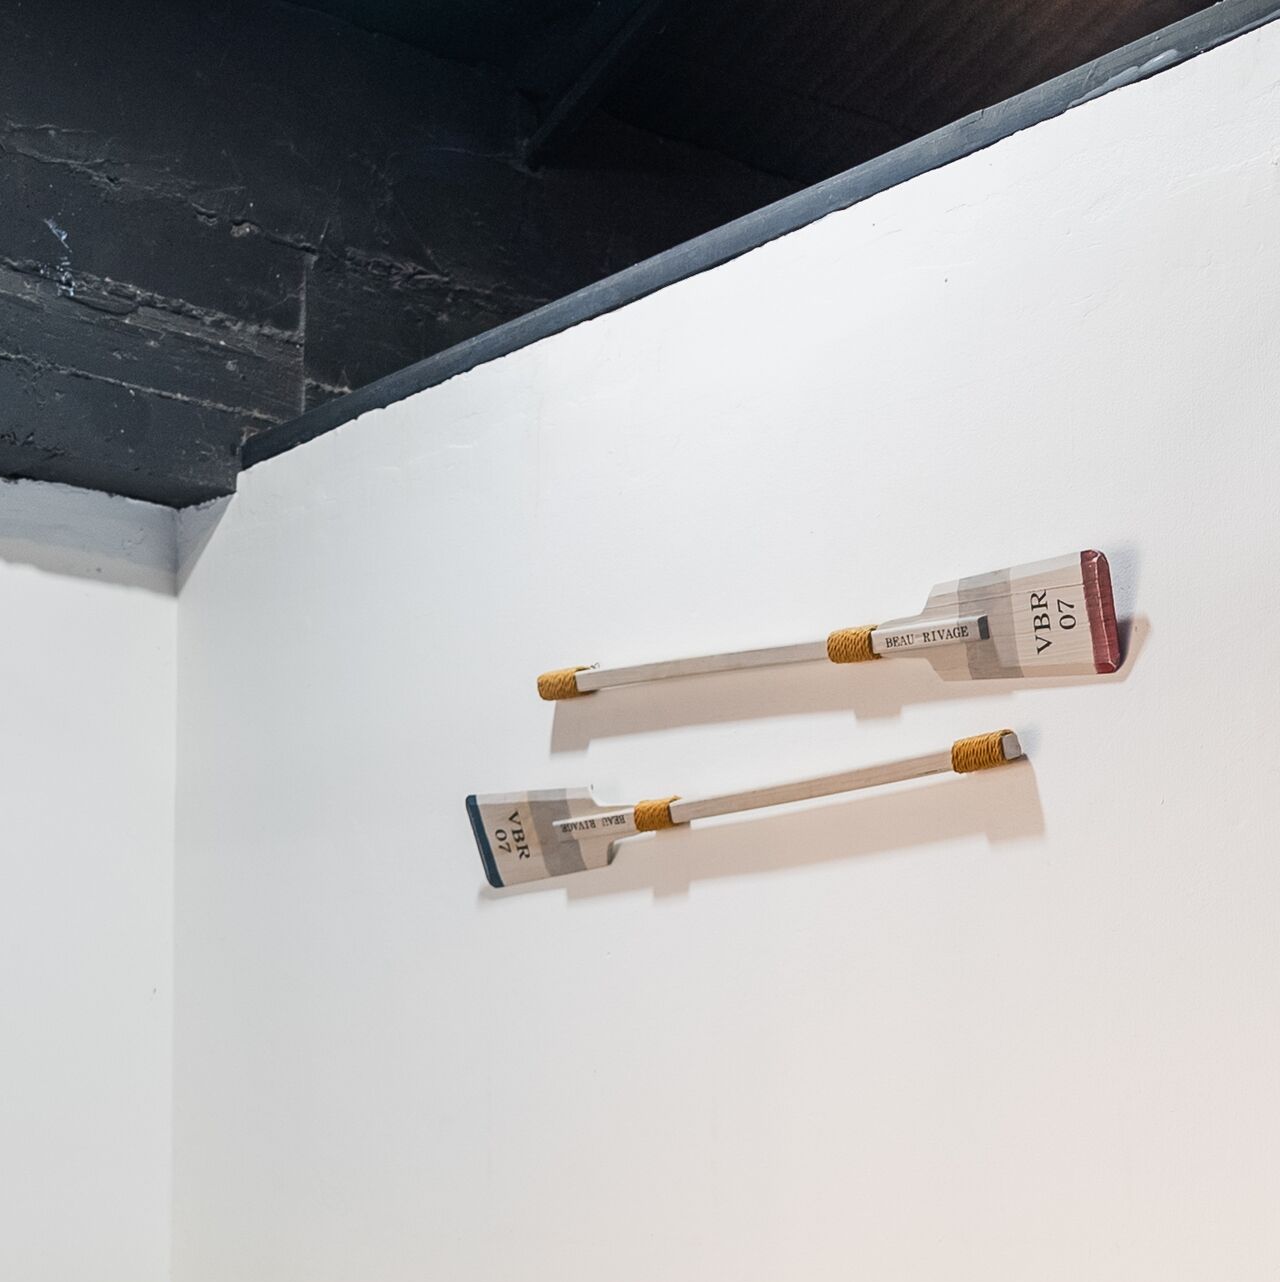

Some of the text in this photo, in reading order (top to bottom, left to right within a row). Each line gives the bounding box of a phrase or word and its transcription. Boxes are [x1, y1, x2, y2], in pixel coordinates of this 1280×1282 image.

[1031, 589, 1053, 654] VBR
[1057, 599, 1076, 630] 07
[885, 625, 970, 648] BEAU RIVAGE
[601, 814, 626, 827] BEAU
[495, 829, 512, 853] 07
[508, 811, 530, 859] VBR
